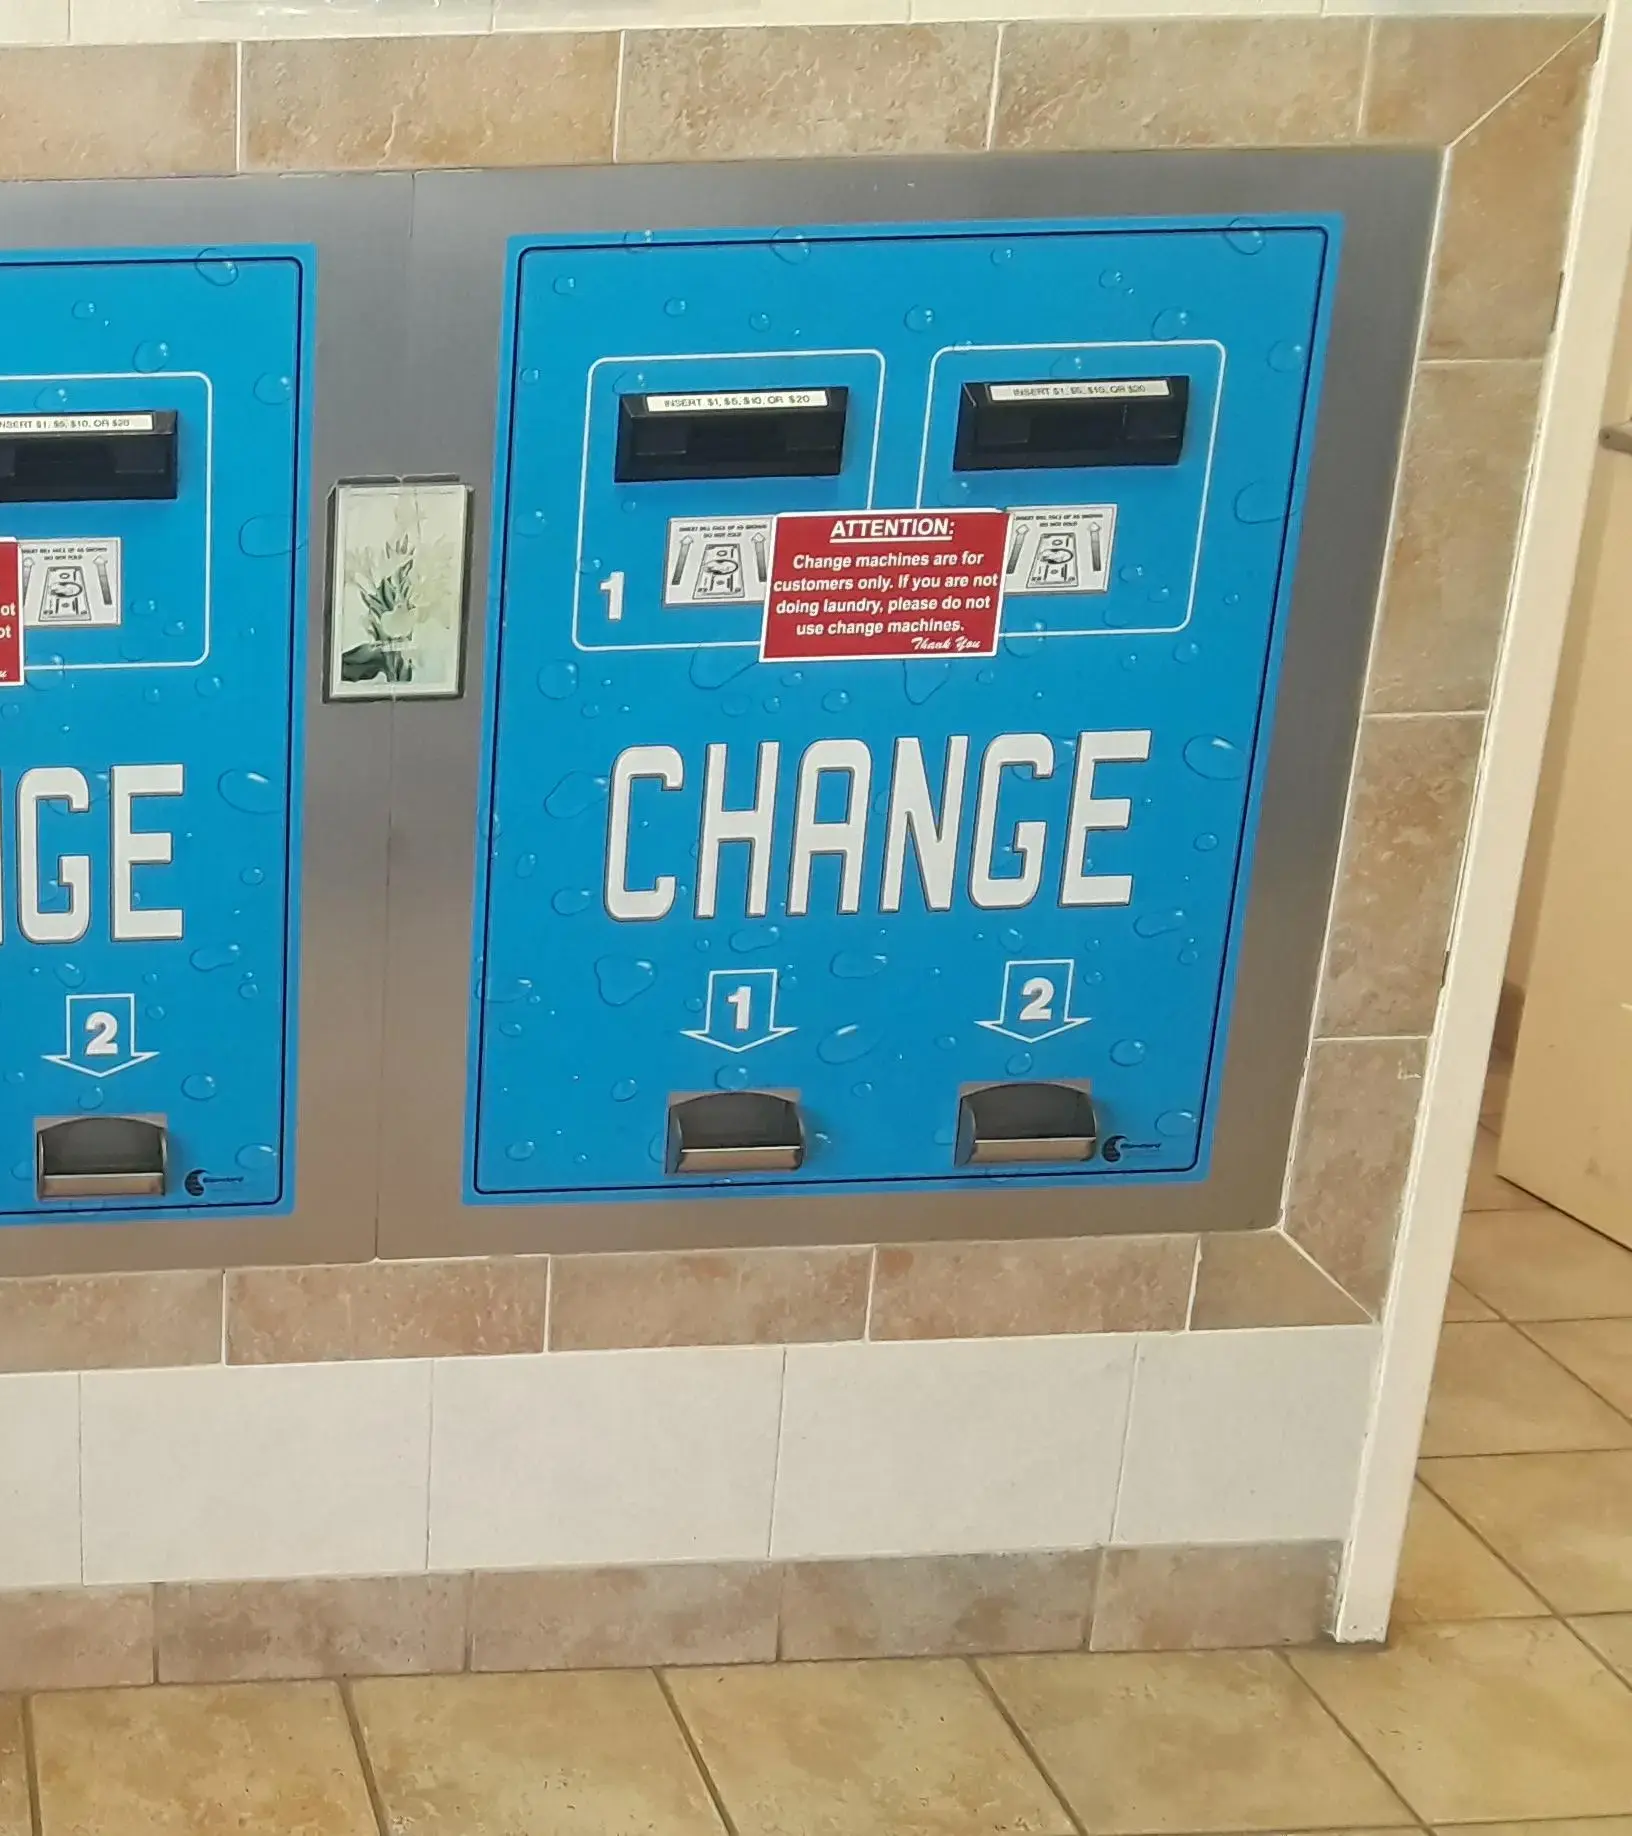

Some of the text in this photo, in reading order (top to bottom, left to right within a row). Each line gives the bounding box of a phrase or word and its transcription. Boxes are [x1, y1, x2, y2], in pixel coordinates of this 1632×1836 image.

[767, 395, 784, 405] OR
[788, 394, 810, 404] $20
[93, 418, 109, 428] OR
[111, 418, 130, 428] $20
[831, 518, 956, 538] ATTENTION:
[793, 550, 984, 571] Change machines are for
[773, 573, 999, 592] customers only. If you are not
[599, 571, 626, 621] 1
[776, 595, 990, 616] doing laundry, please do not
[796, 617, 965, 637] use change machines.
[910, 635, 981, 651] Thank You
[603, 729, 1153, 922] CHANGE
[727, 985, 753, 1031] 1
[1019, 977, 1055, 1021] 2
[84, 1011, 119, 1056] 2
